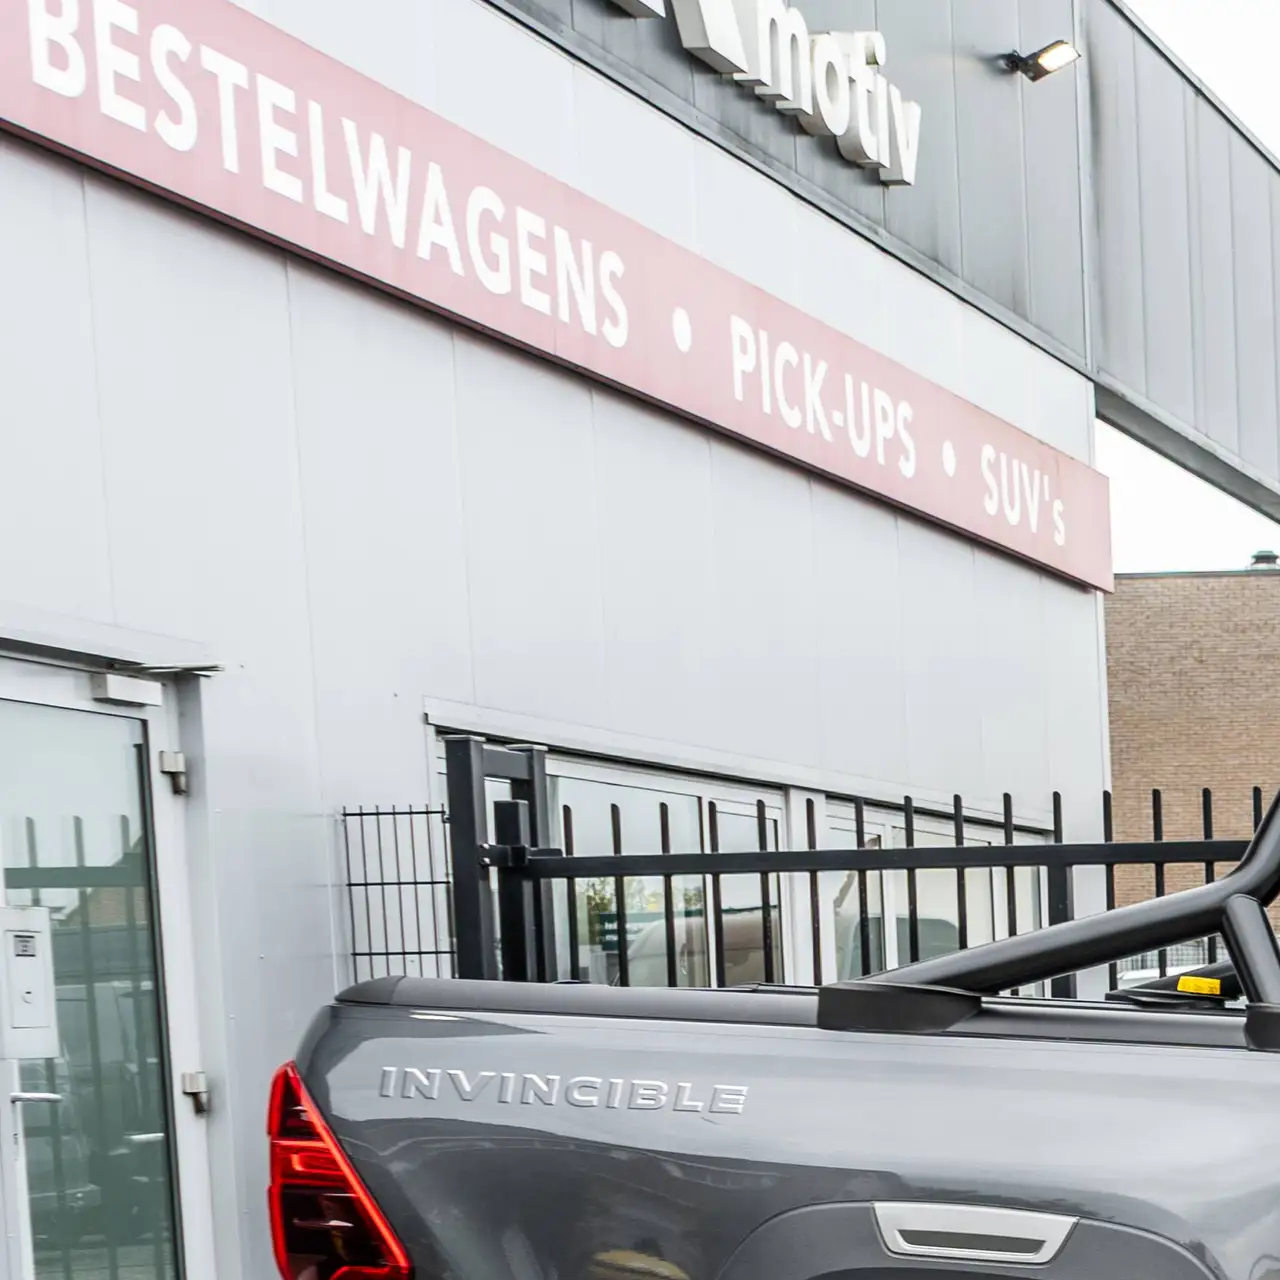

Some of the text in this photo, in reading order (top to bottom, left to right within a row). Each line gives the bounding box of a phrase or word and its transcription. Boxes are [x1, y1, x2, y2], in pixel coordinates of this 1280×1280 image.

[27, 0, 630, 348] BESTELWAGENS
[729, 314, 917, 480] PICK-UPS
[979, 441, 1066, 546] SUV's
[378, 1065, 750, 1115] INVINCIBLE
